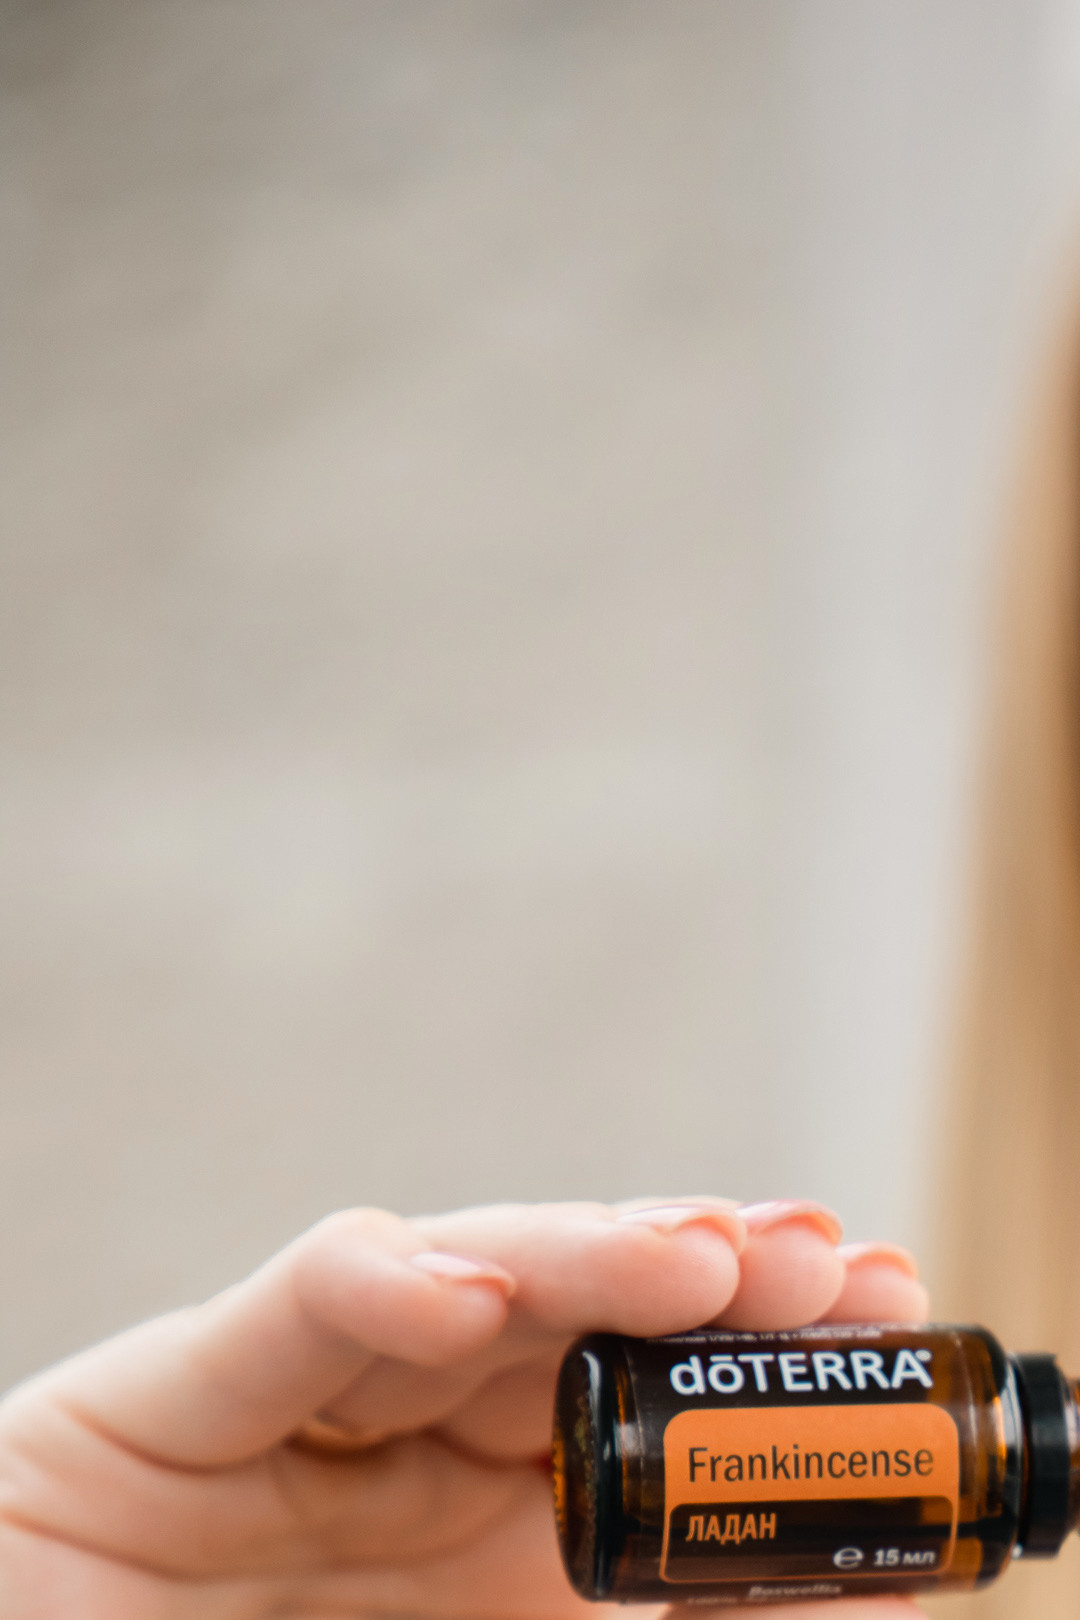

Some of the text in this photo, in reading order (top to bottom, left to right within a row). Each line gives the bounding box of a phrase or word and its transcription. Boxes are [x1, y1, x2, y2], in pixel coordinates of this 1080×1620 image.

[688, 1444, 934, 1483] Frankincense
[685, 1512, 777, 1546] ЛАДАН
[873, 1548, 899, 1567] 15
[902, 1550, 936, 1566] мл
